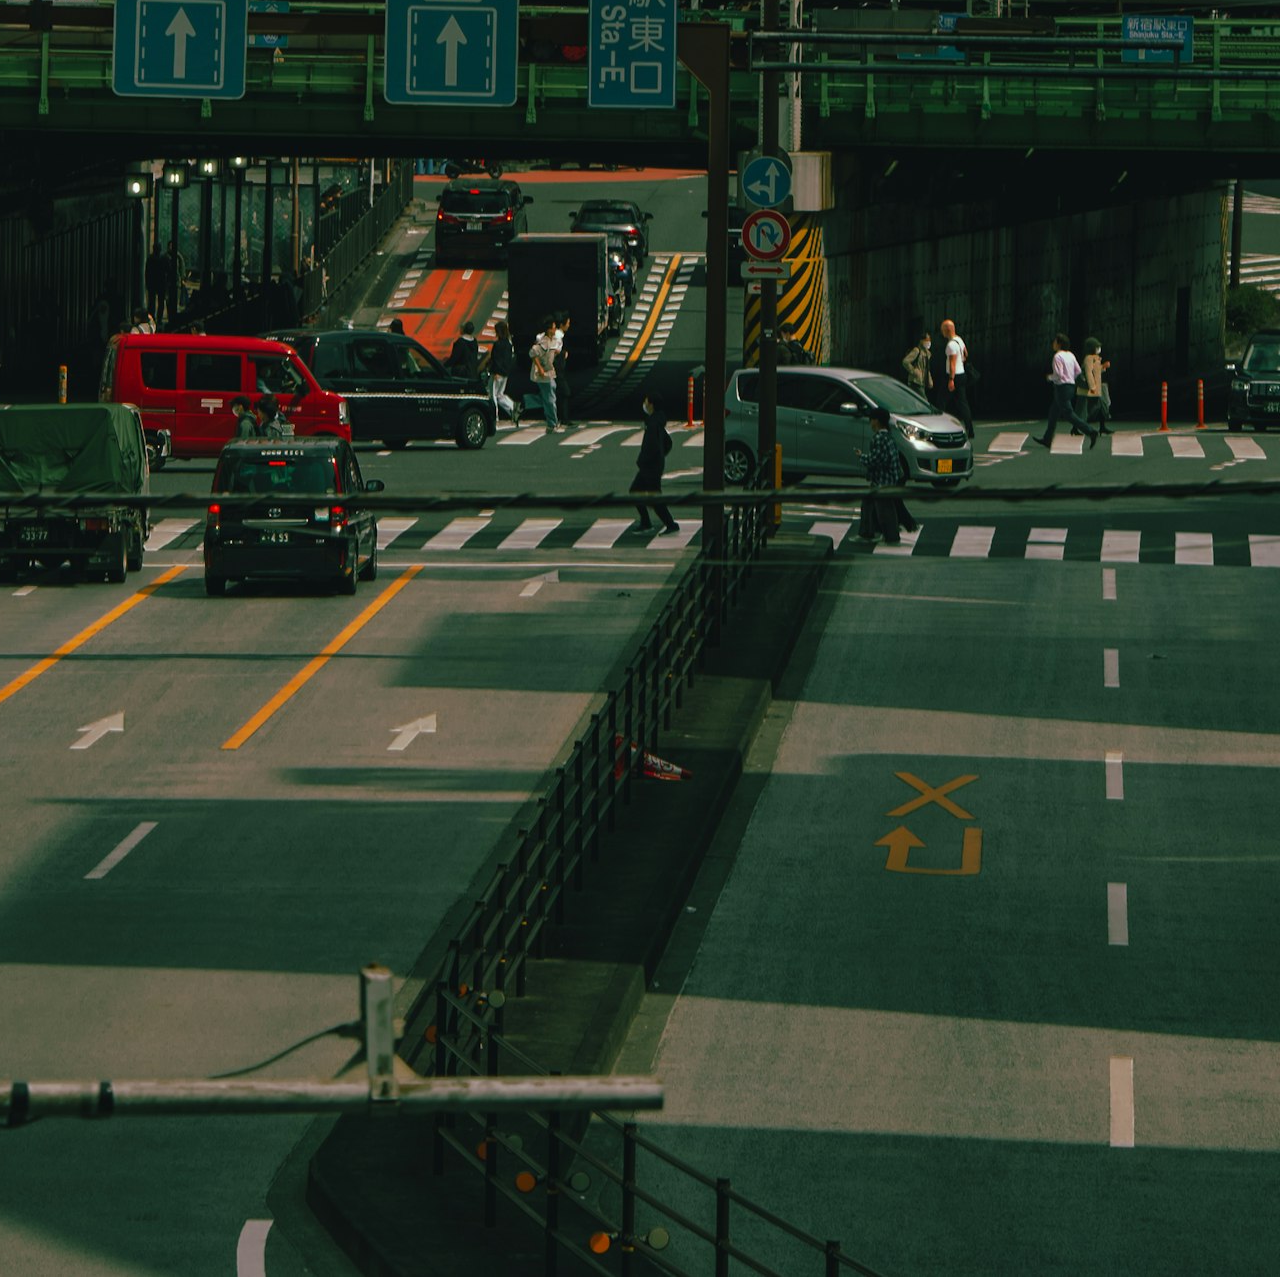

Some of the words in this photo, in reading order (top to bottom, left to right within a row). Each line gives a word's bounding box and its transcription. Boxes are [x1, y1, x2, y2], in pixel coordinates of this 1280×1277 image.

[1127, 17, 1188, 32] 新宿駅東口
